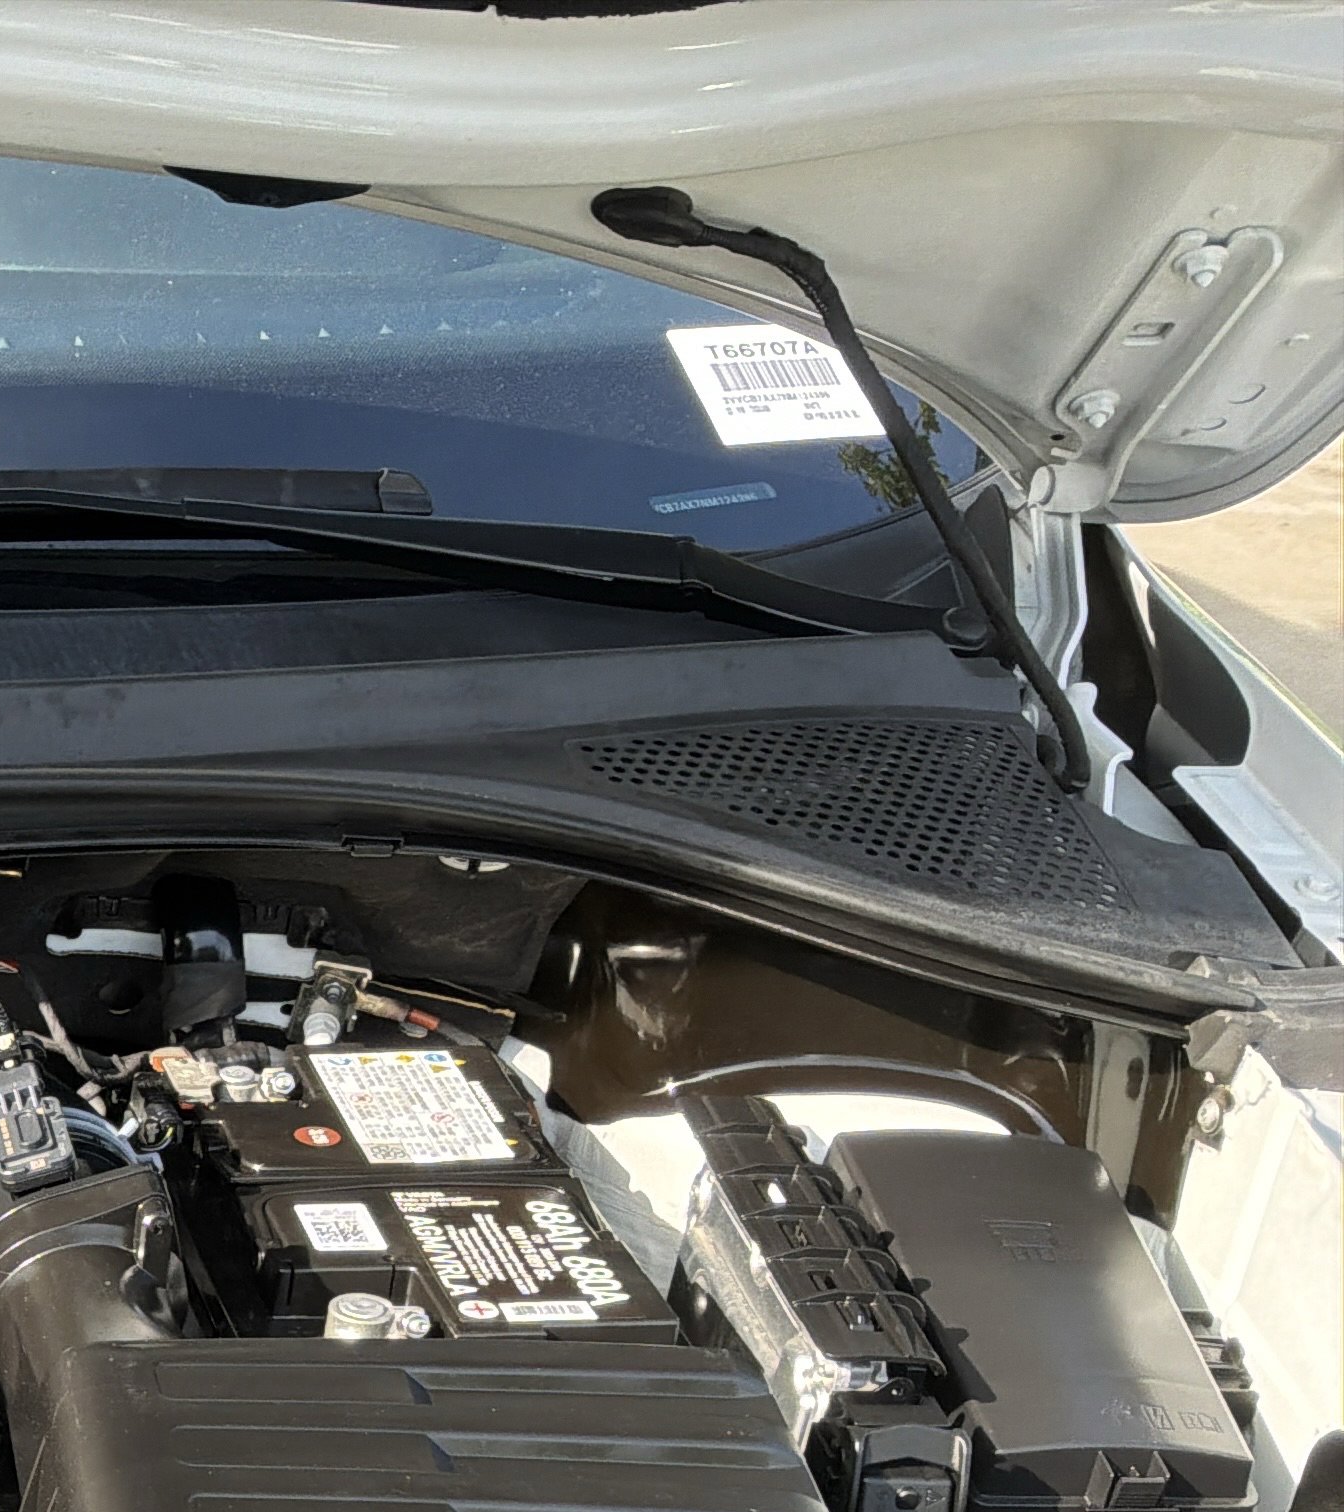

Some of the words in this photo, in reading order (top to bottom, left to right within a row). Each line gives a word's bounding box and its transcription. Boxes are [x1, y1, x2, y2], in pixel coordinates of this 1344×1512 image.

[704, 341, 819, 359] T66707A
[524, 1200, 592, 1251] 68Ah
[561, 1254, 631, 1307] 680A
